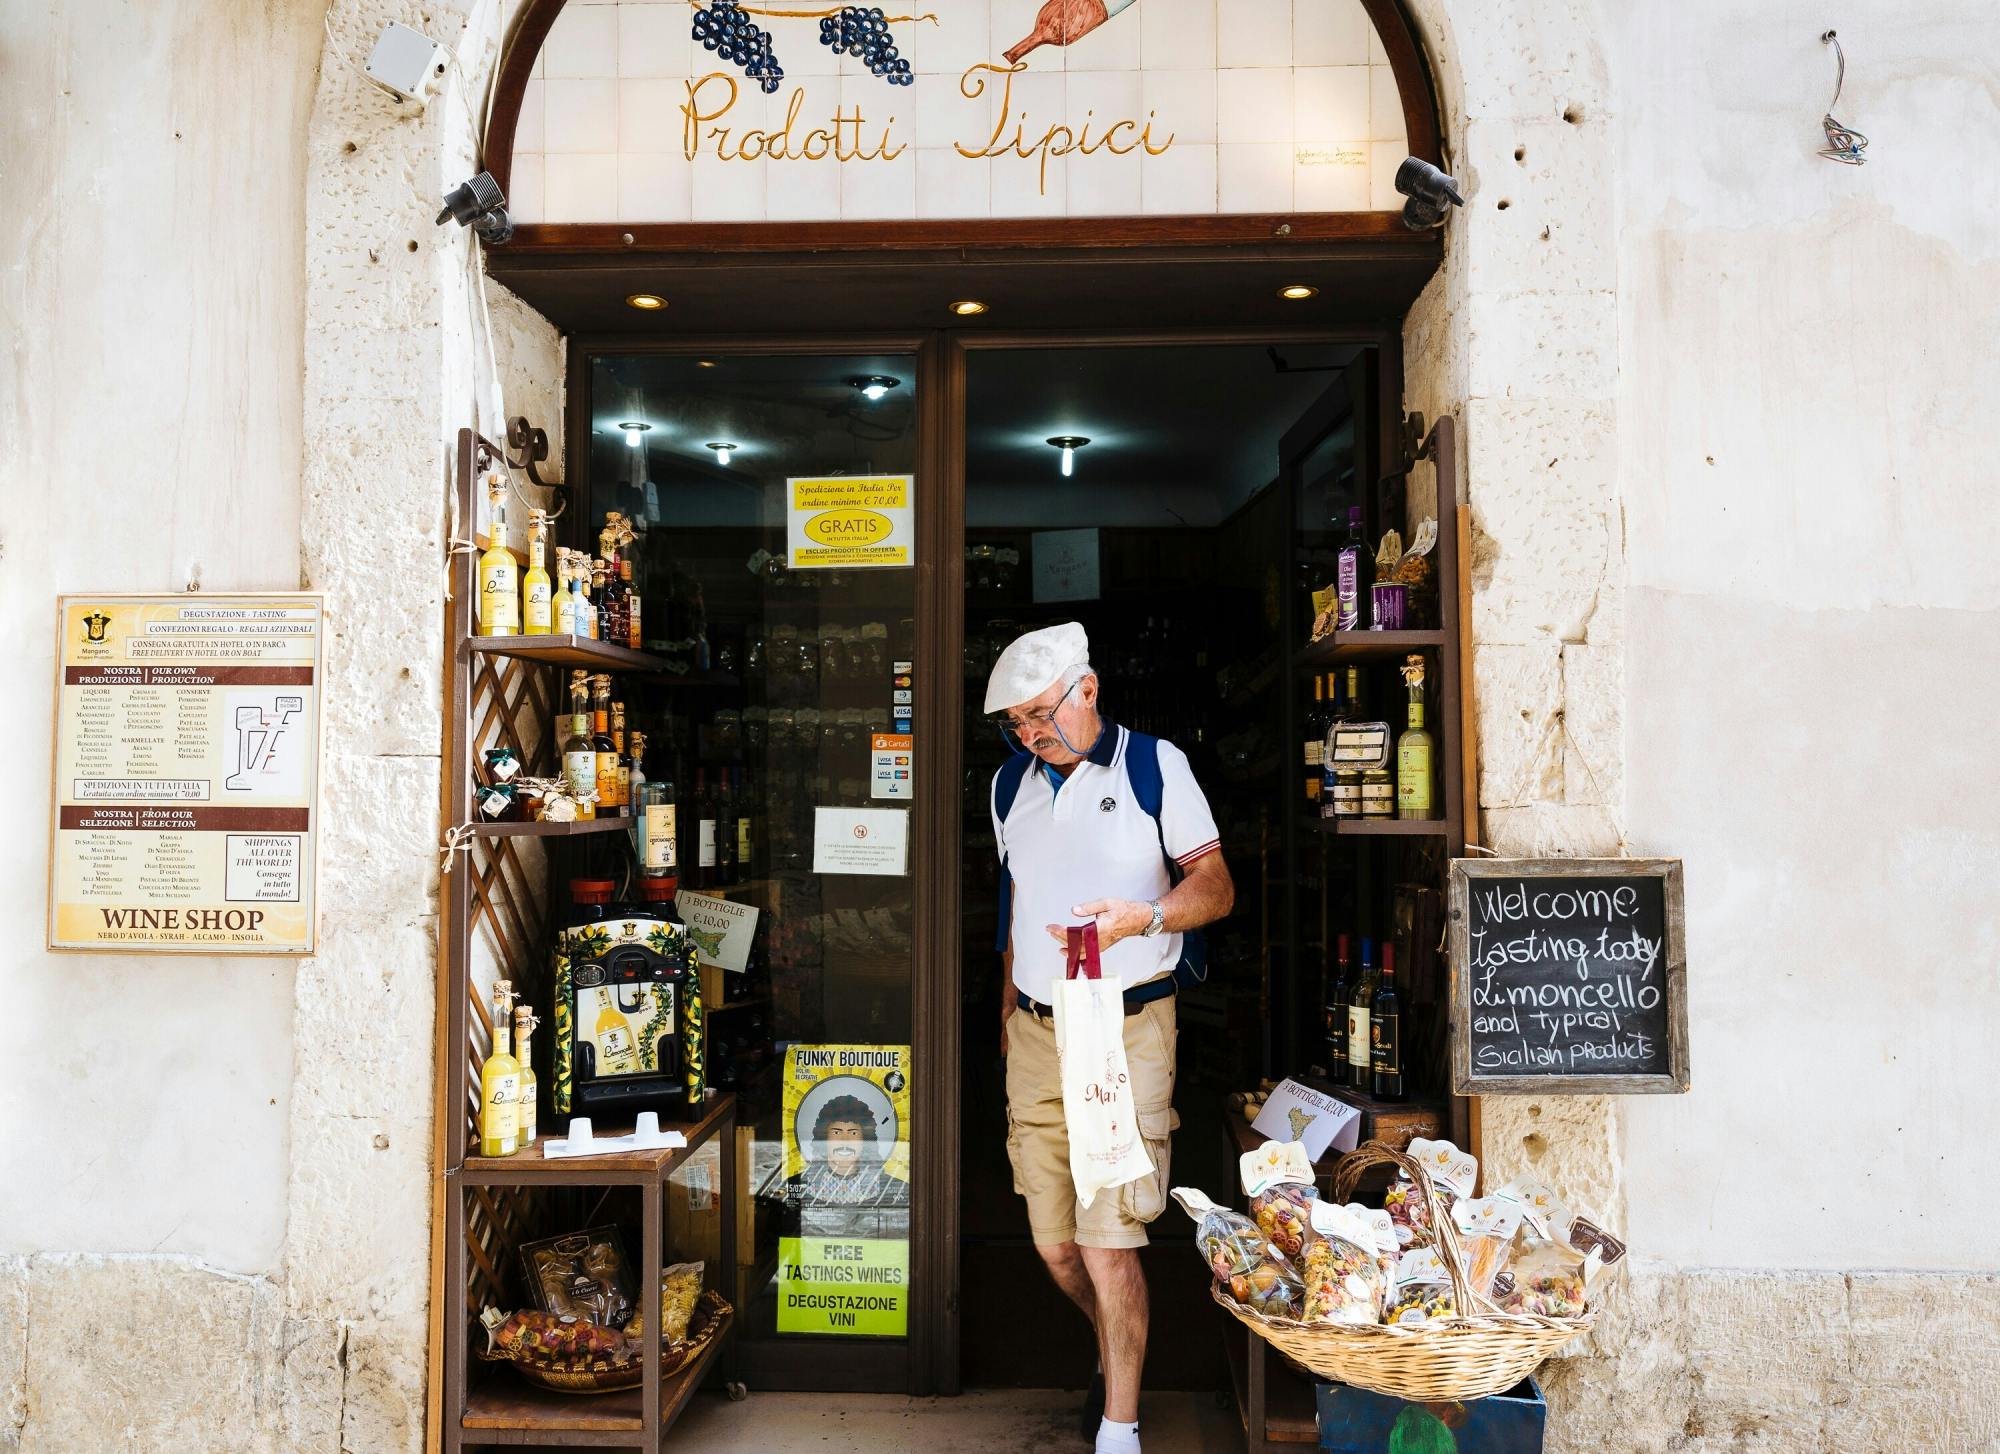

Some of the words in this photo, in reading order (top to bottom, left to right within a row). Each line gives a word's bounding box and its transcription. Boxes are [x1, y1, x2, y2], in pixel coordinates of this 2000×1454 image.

[680, 72, 908, 162] Prodotti
[954, 62, 1174, 196] Tipici
[799, 485, 845, 495] Spedizione
[847, 484, 854, 492] in
[858, 484, 884, 492] Italia
[887, 483, 901, 492] Per
[802, 498, 828, 506] ordine
[831, 498, 860, 506] minimo
[864, 497, 870, 505] €
[820, 519, 876, 533] GRATIS
[269, 625, 312, 633] AZIENDALI
[249, 849, 268, 857] ALL
[270, 849, 292, 857] OVER
[236, 858, 254, 866] THE
[256, 859, 292, 867] WORLD!
[257, 870, 292, 880] Consegne
[275, 880, 291, 888] tutto
[256, 890, 262, 898] il
[263, 890, 291, 898] mondo!
[685, 897, 691, 905] 3
[693, 898, 745, 917] BOTTIGLIE
[1475, 883, 1639, 922] Welcome
[100, 909, 179, 929] WINE
[185, 910, 264, 930] SHOP
[120, 932, 154, 940] D'AVOLA
[232, 933, 264, 941] INSOLIA
[1473, 966, 1660, 1009] Limoncello
[1474, 1007, 1520, 1034] and
[1529, 1009, 1621, 1044] typical
[796, 1051, 836, 1065] FUNKY
[840, 1052, 899, 1067] BOUTIQUE
[1476, 1038, 1562, 1067] Sicilian
[824, 1245, 864, 1260] FREE
[784, 1264, 853, 1282] TASTINGS
[858, 1266, 902, 1284] WINES
[788, 1294, 897, 1310] DEGUSTAZIONE
[829, 1312, 856, 1326] VINI
